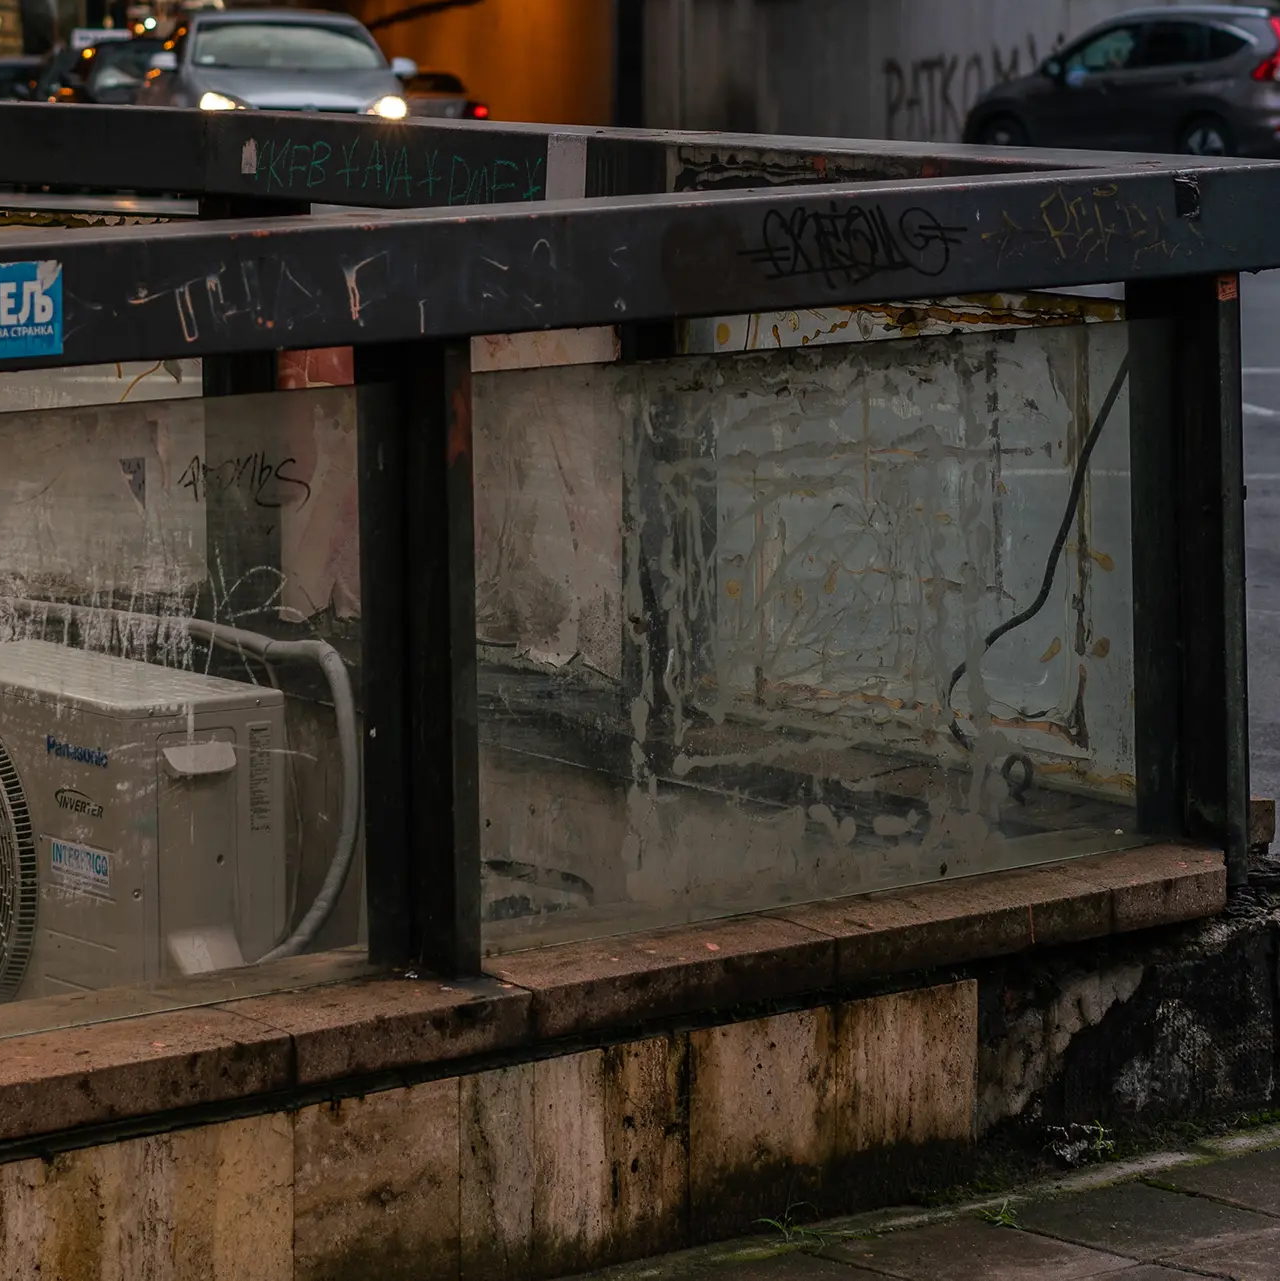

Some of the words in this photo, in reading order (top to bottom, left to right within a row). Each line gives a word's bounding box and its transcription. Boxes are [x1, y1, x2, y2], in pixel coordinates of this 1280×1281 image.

[10, 324, 54, 339] СТРАНКА
[46, 733, 109, 769] Panasonic
[59, 793, 104, 819] INVERTER
